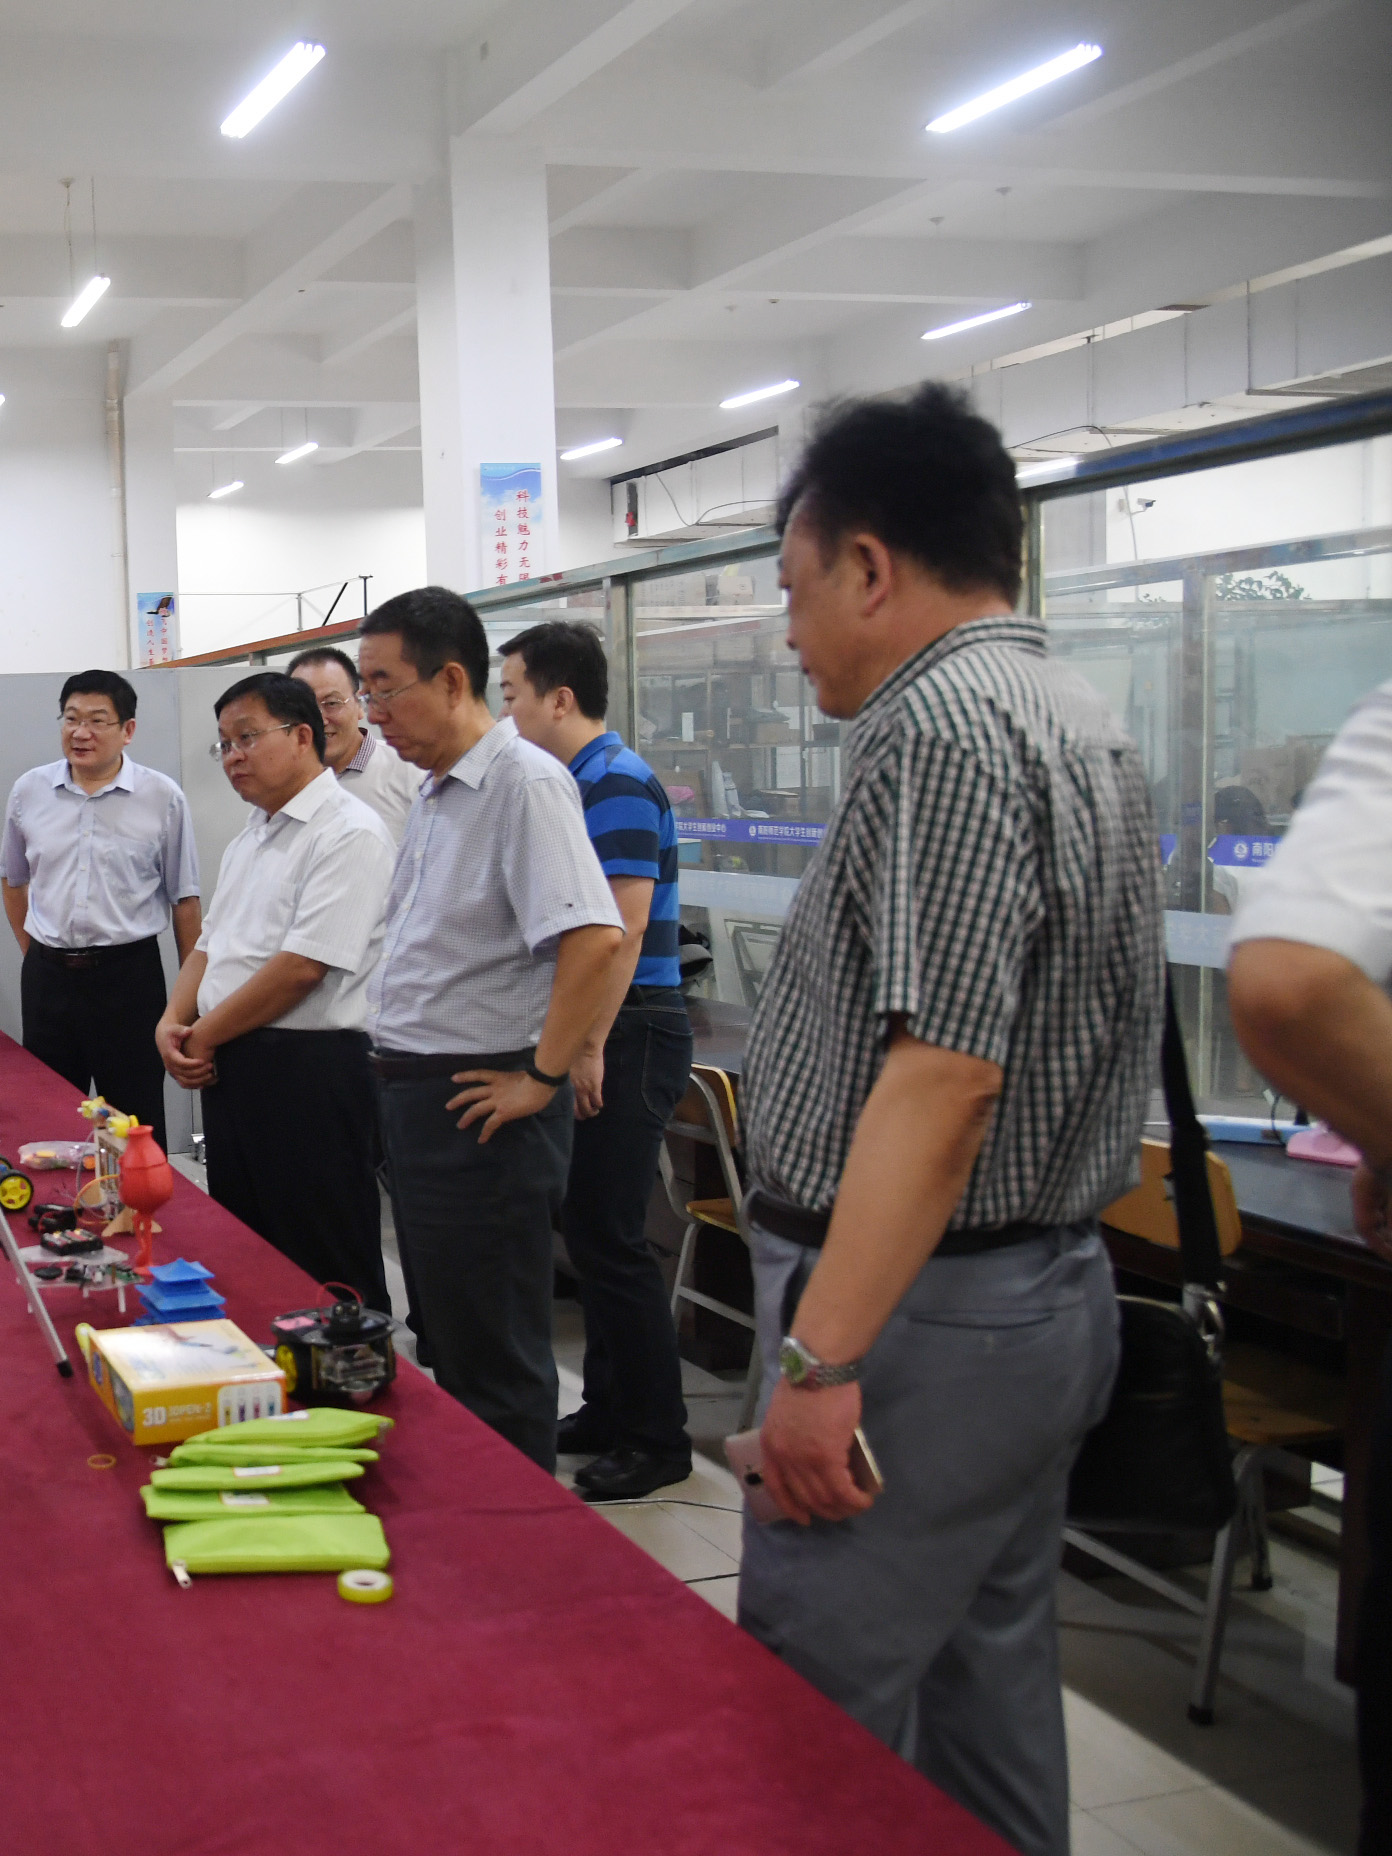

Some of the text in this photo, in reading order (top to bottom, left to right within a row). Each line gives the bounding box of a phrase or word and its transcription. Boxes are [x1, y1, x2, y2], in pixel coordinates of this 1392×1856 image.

[494, 508, 508, 586] 创业精彩有
[143, 1406, 167, 1427] 3D
